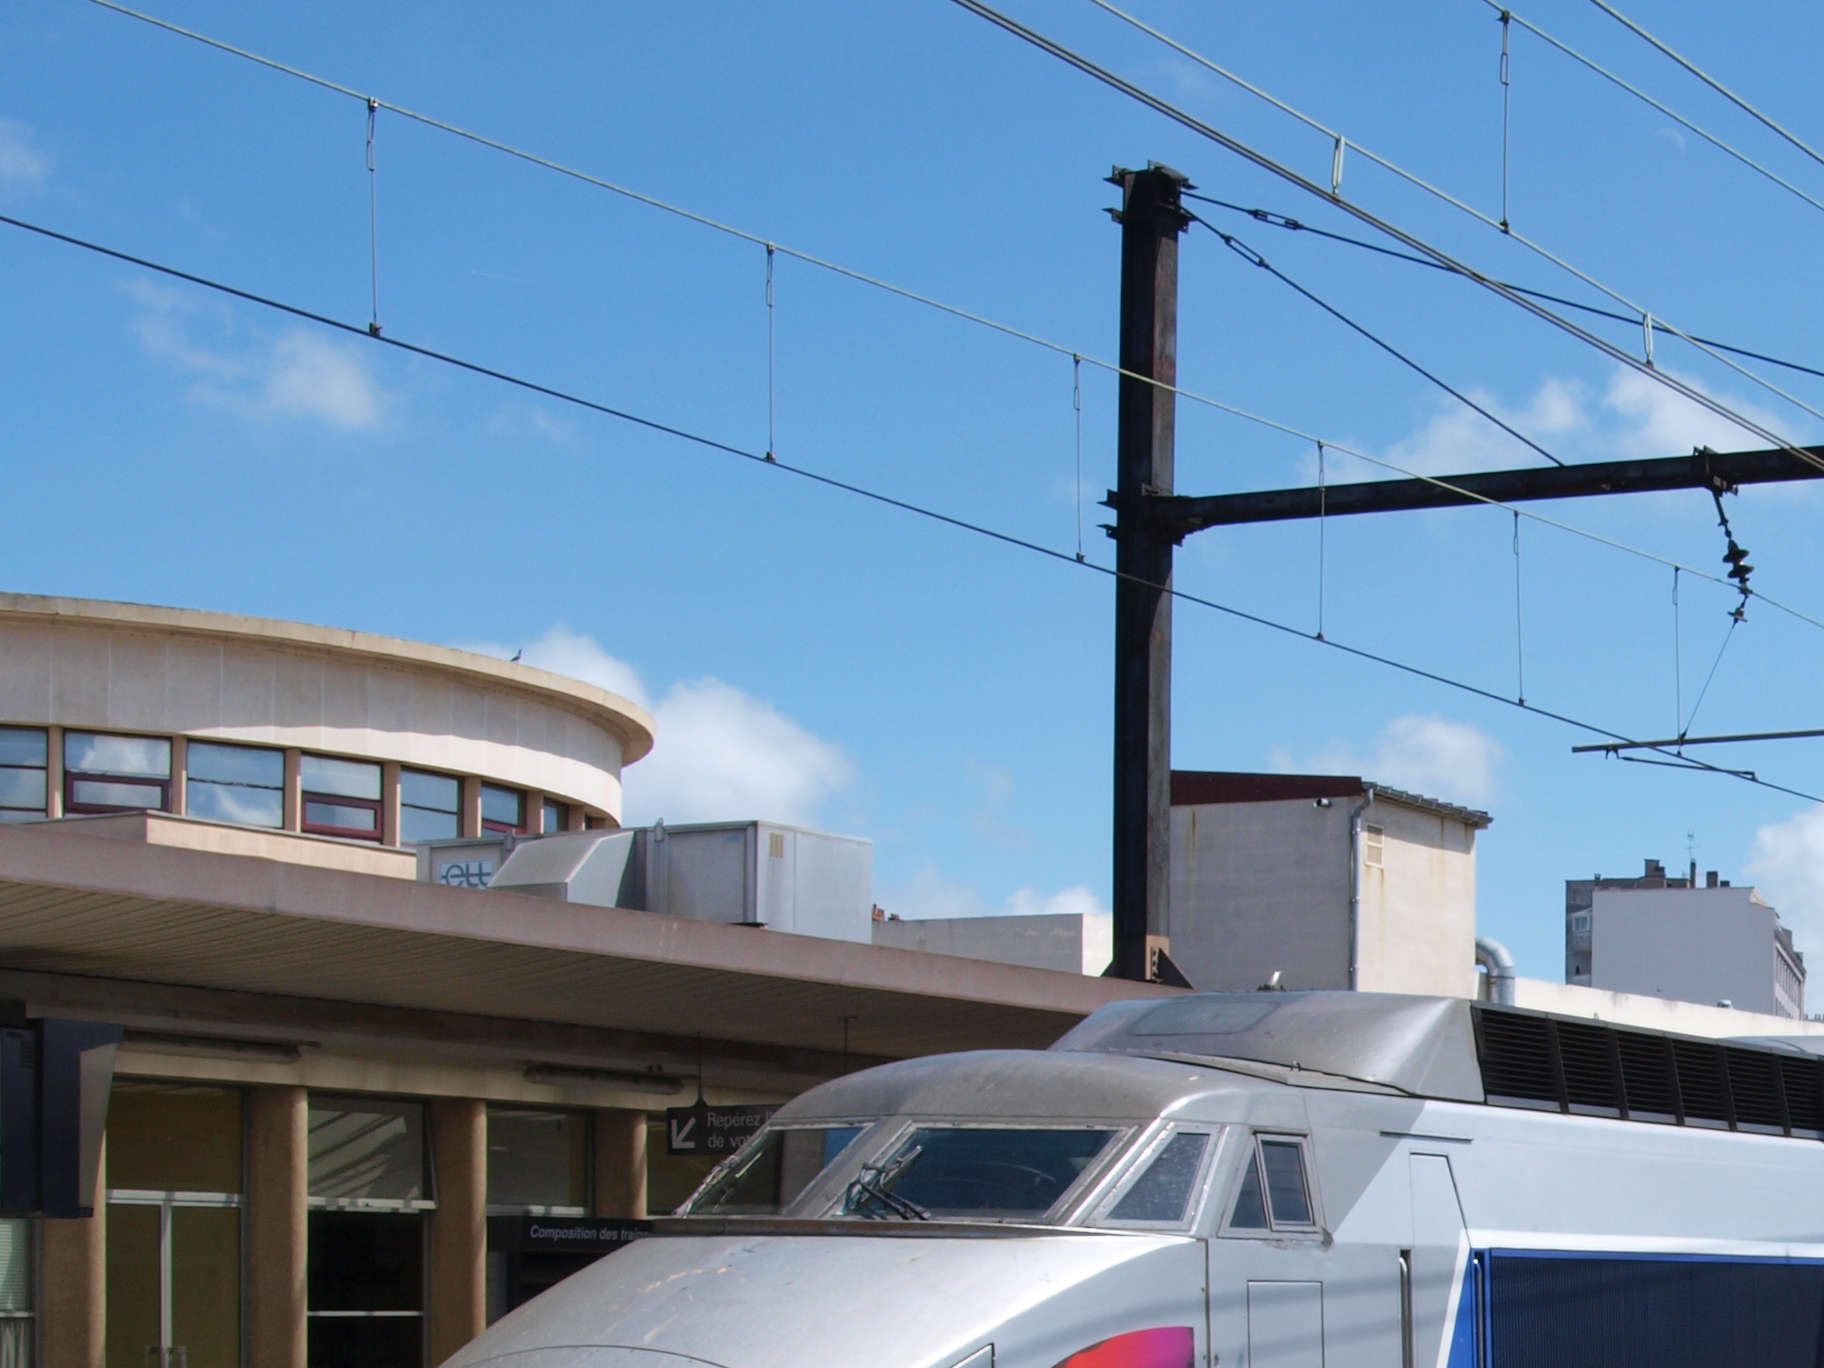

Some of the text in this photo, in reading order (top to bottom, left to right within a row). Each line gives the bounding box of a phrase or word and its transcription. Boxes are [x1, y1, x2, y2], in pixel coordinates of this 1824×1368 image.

[707, 1111, 761, 1131] Repérez
[708, 1132, 724, 1148] de
[530, 1224, 597, 1241] Composition
[600, 1227, 619, 1241] des
